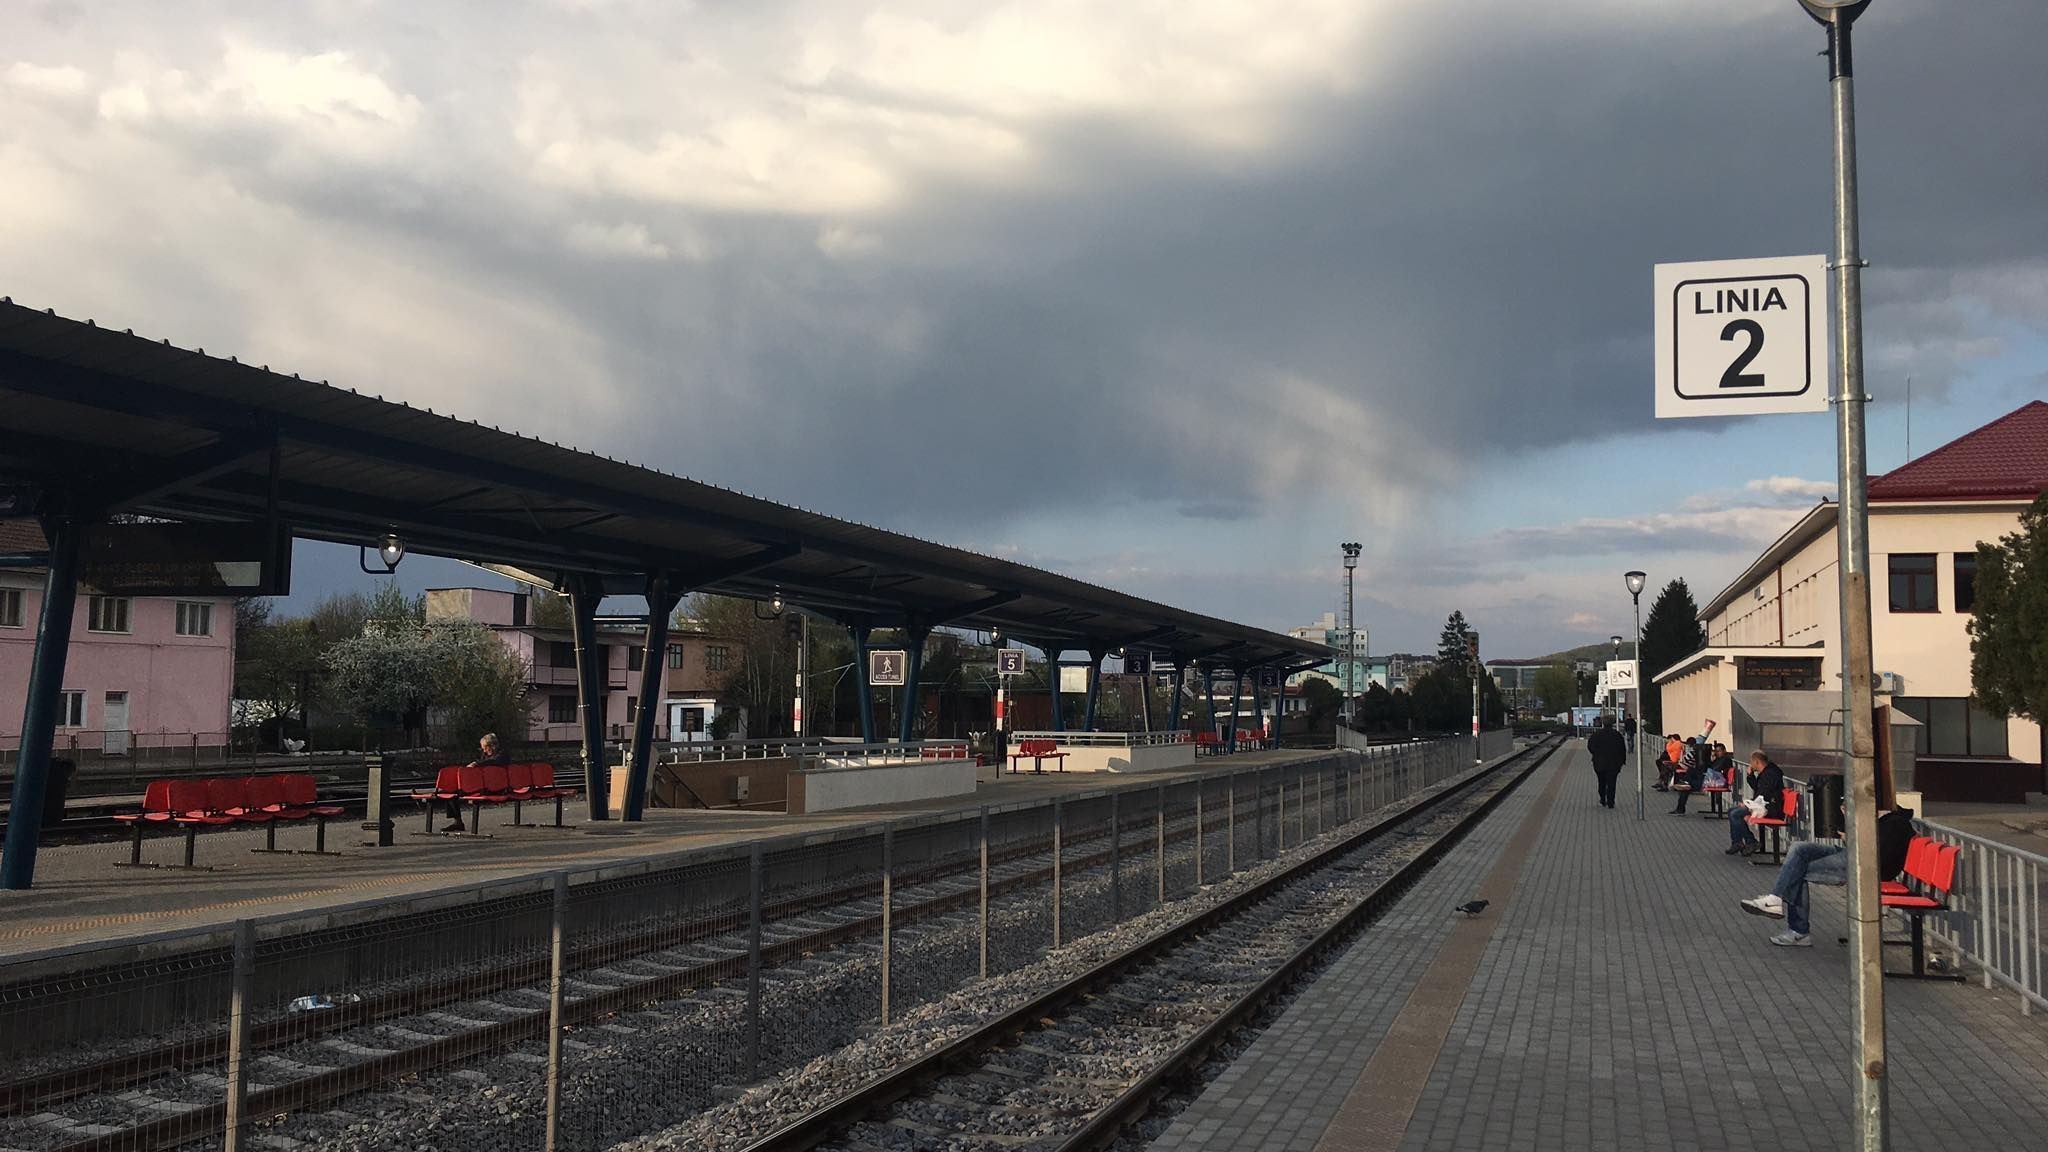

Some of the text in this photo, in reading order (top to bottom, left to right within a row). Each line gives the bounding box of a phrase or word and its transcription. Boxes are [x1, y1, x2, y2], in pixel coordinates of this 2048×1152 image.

[1695, 287, 1787, 315] LINIA
[1718, 318, 1765, 388] 2
[1007, 659, 1015, 670] 5
[1133, 660, 1141, 672] 3
[1618, 670, 1631, 678] 2
[1266, 676, 1272, 685] 3
